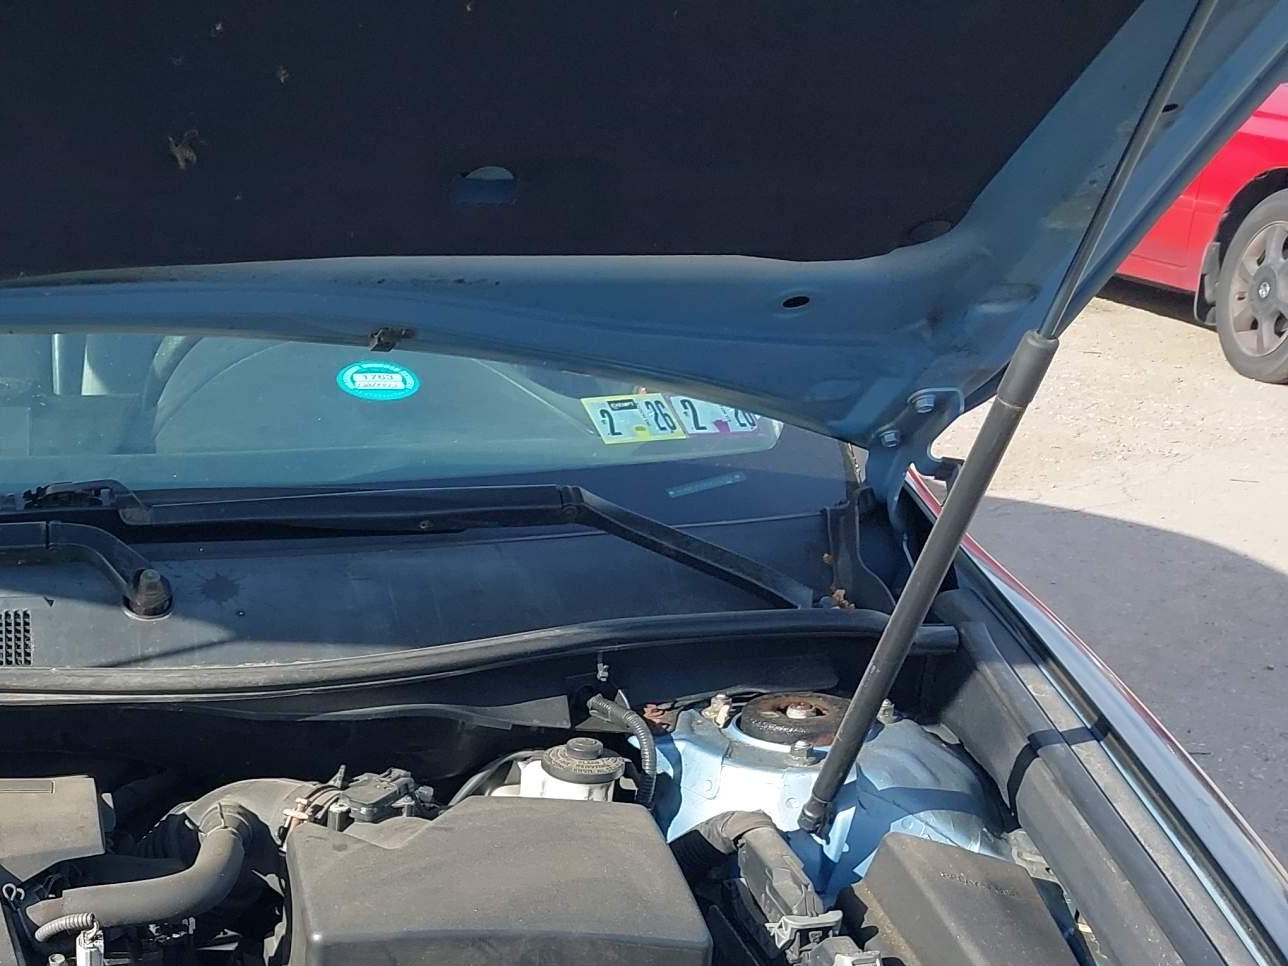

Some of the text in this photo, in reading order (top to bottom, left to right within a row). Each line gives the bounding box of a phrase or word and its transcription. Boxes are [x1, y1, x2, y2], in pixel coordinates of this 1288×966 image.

[600, 408, 622, 436] 2
[644, 400, 677, 431] 26
[679, 399, 708, 431] 2
